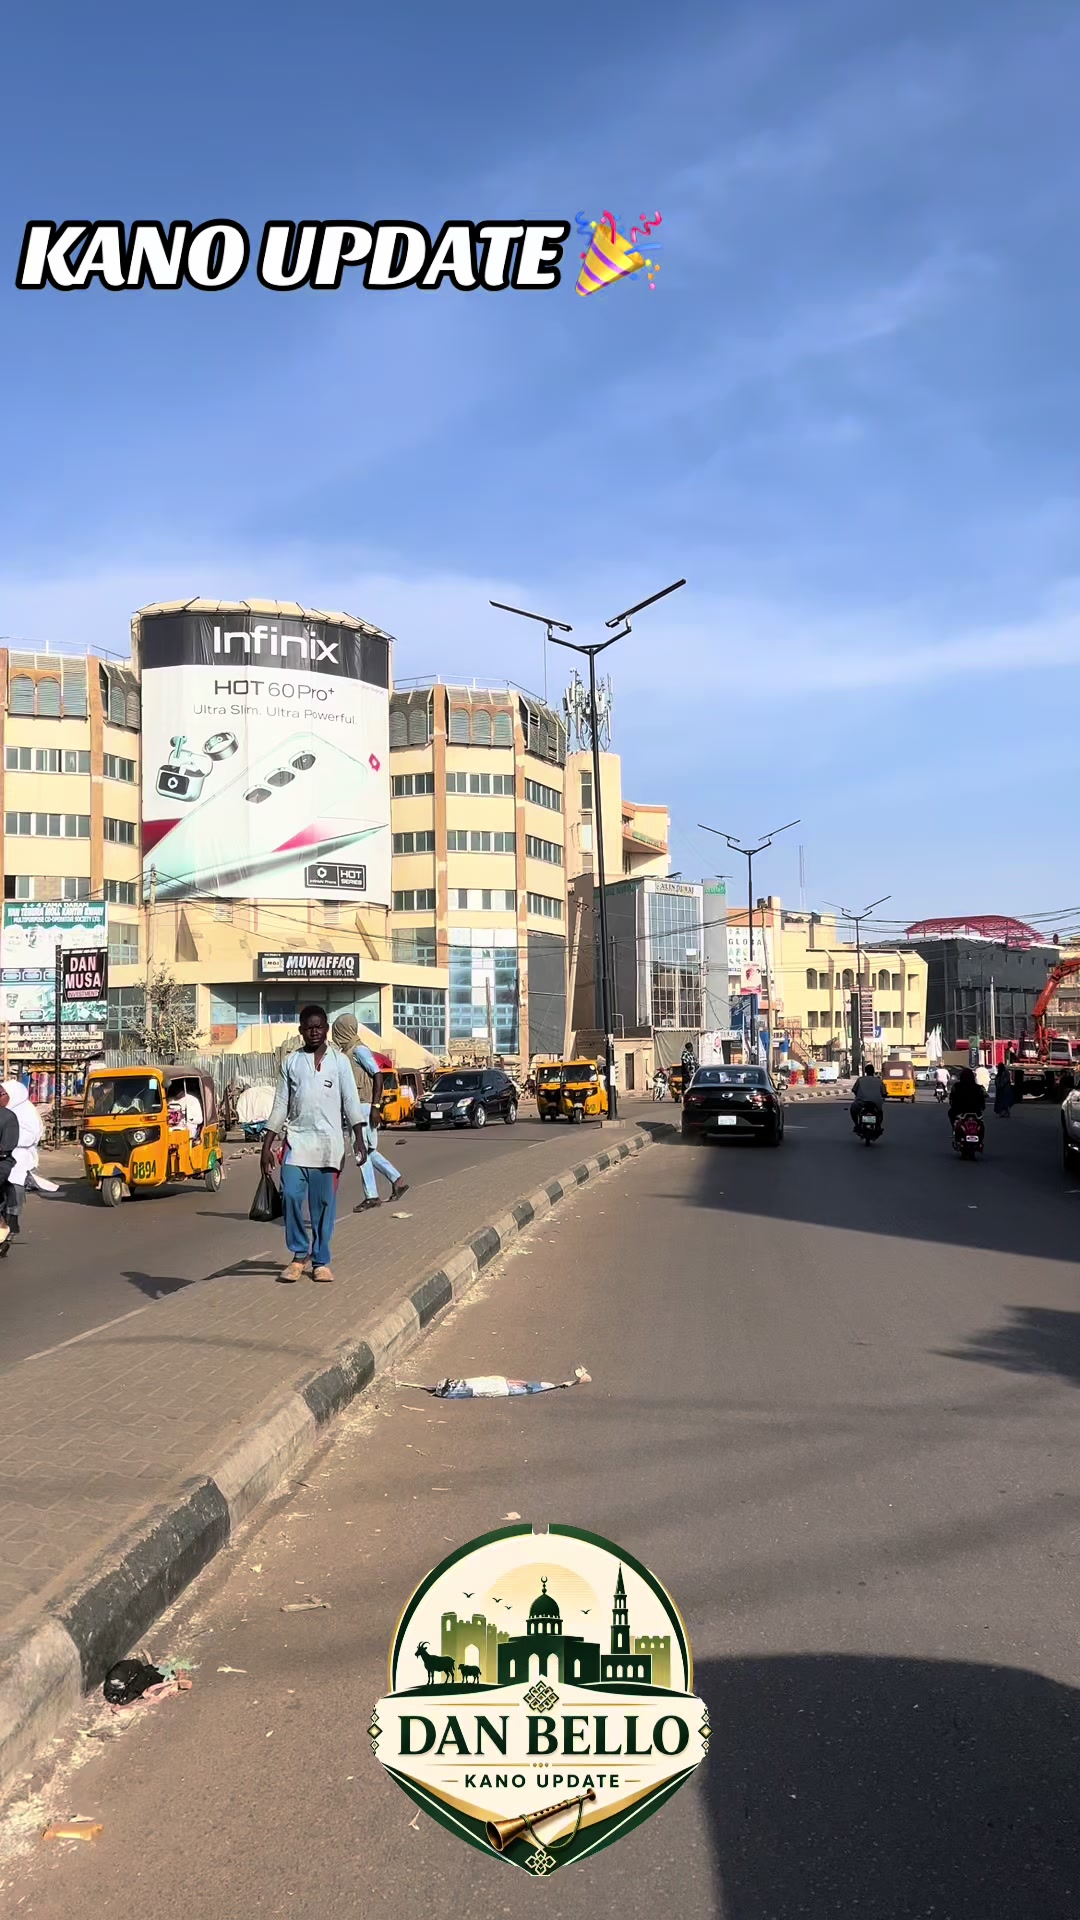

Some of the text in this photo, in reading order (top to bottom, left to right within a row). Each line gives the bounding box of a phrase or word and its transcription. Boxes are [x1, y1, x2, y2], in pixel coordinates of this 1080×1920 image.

[213, 625, 339, 664] Infinix
[214, 680, 264, 695] HOT
[193, 704, 358, 725] Ultra Slim. Ultra Powerful.
[340, 869, 362, 879] HOT
[70, 956, 97, 971] DAN
[286, 955, 355, 969] MUWAFFAQ
[65, 972, 101, 989] MUSA
[67, 990, 99, 998] INVESTMENT
